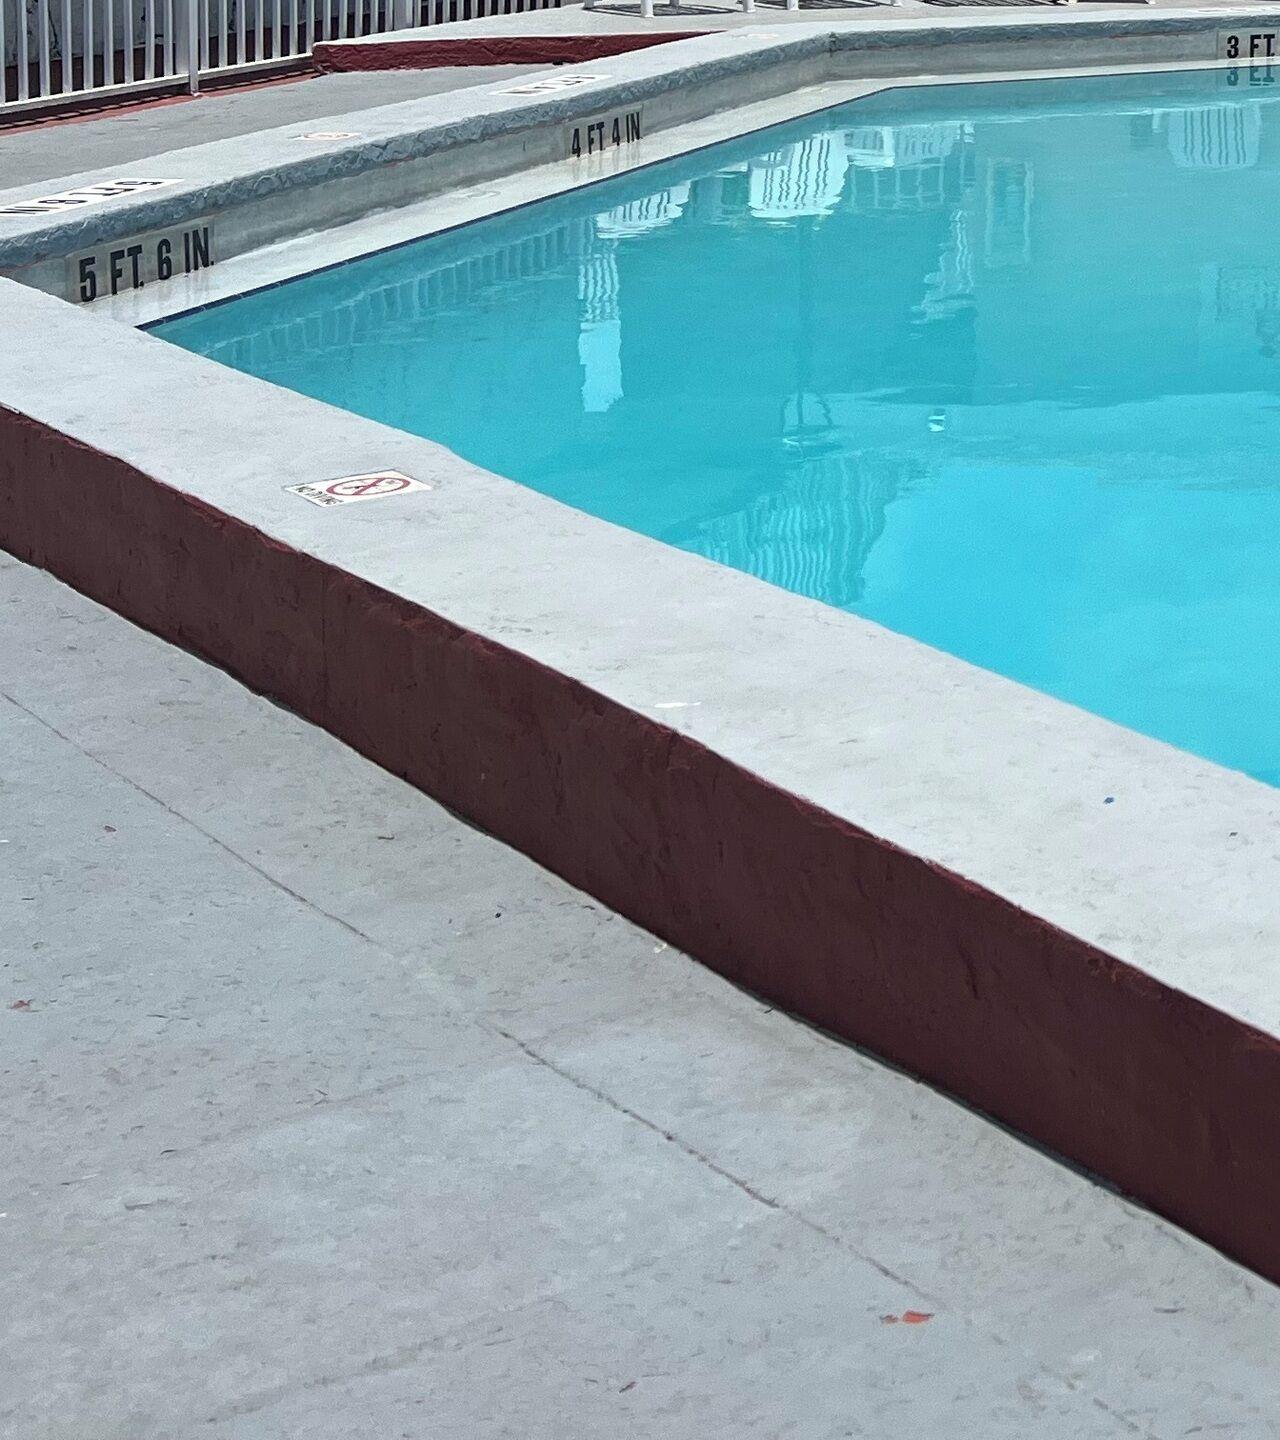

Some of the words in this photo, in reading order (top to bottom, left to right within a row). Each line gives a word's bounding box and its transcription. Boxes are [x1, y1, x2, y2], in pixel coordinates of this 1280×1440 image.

[1226, 35, 1240, 59] 3
[1250, 34, 1276, 58] FT.
[571, 128, 581, 158] 4
[612, 117, 621, 146] 4
[79, 256, 97, 302] 5
[110, 244, 144, 295] FT.
[156, 238, 172, 280] 6
[183, 227, 215, 274] IN.
